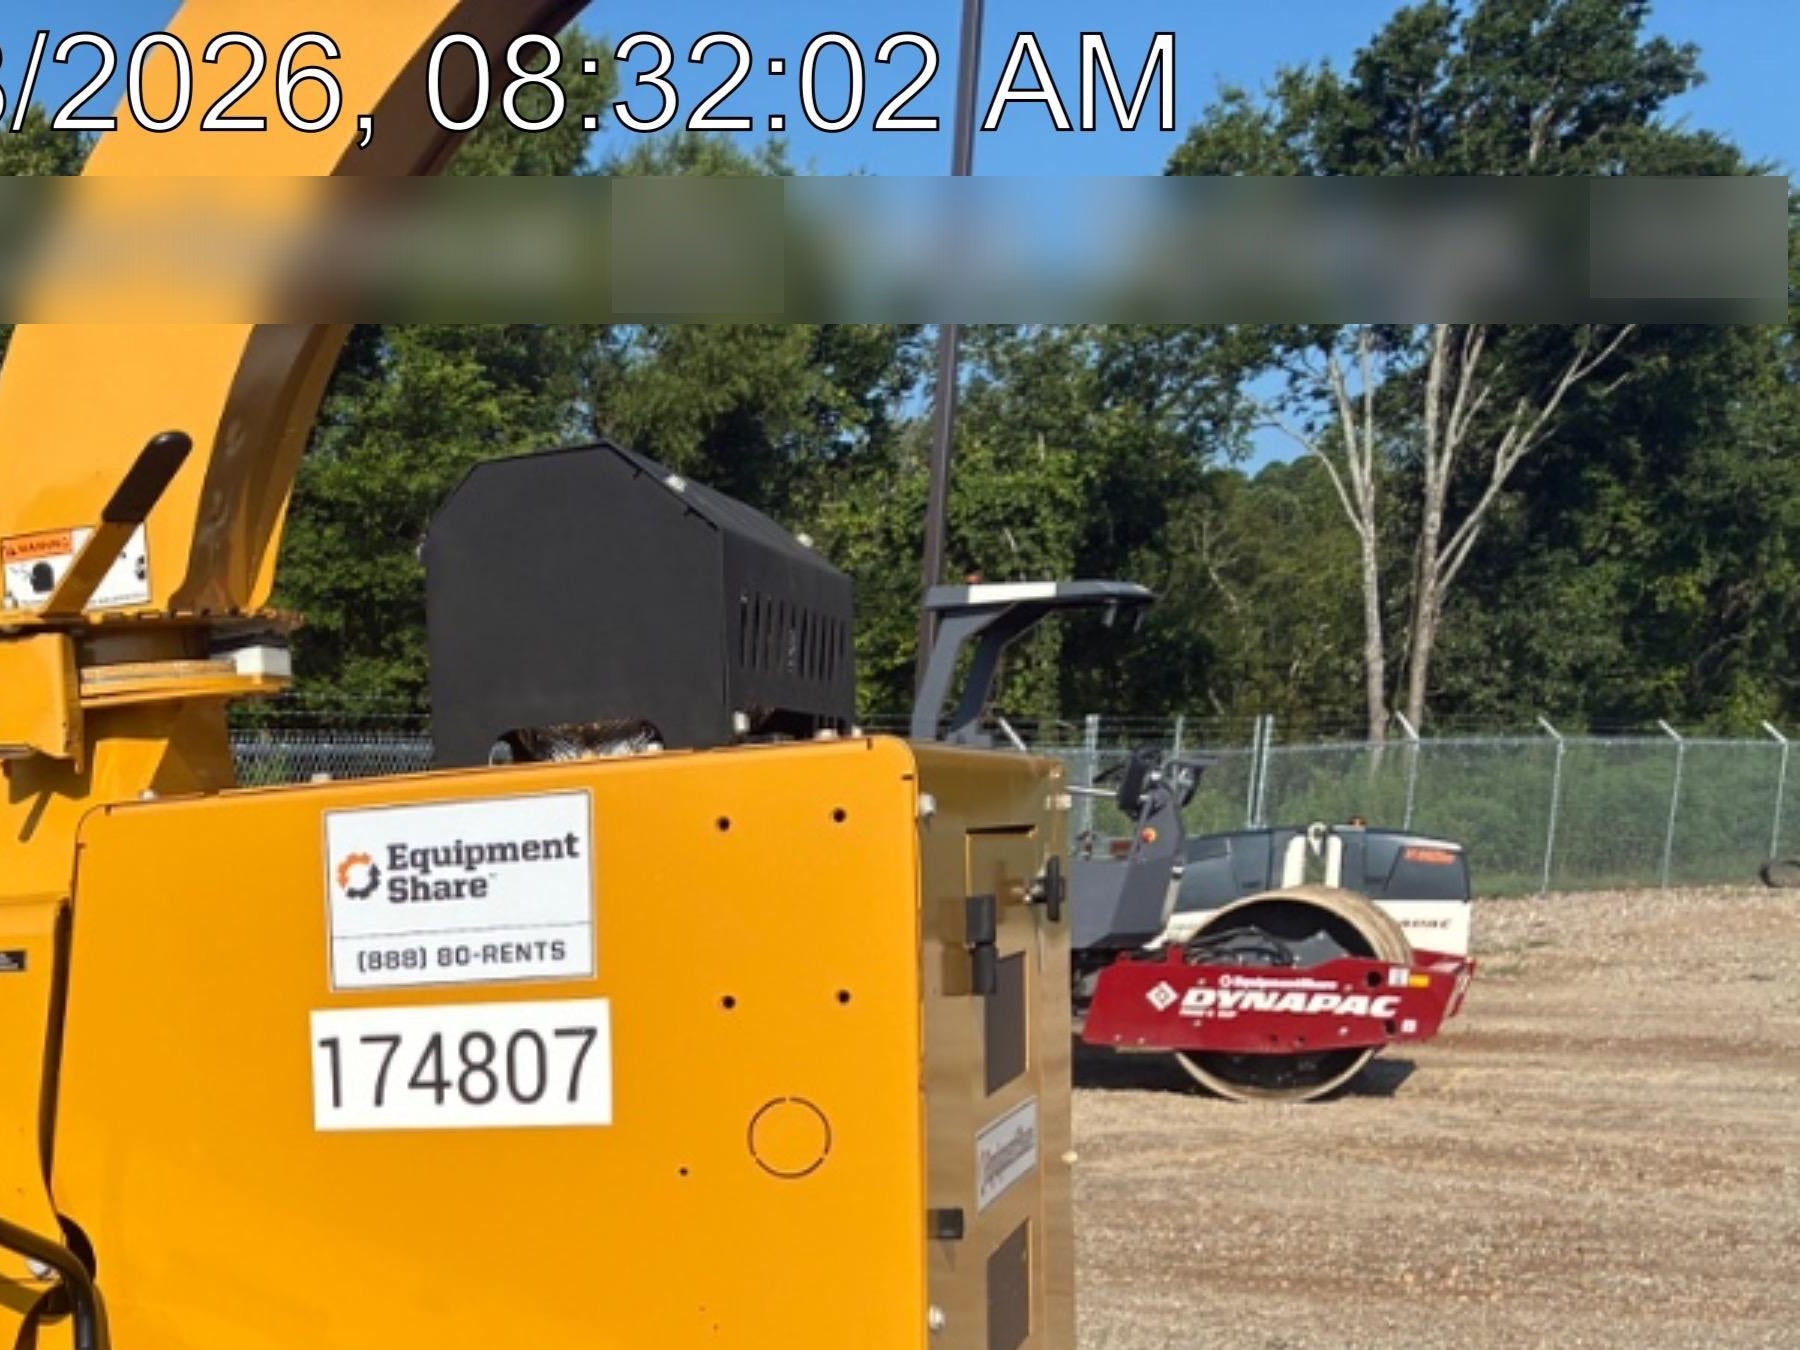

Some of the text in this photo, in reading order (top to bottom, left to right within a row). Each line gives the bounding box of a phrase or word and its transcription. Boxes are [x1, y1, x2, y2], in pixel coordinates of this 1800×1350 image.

[385, 831, 580, 875] Equipment
[386, 873, 489, 904] Share
[357, 939, 567, 974] (888) 80-RENTS
[1179, 987, 1402, 1018] DYNAPAC
[317, 1025, 599, 1109] 174807
